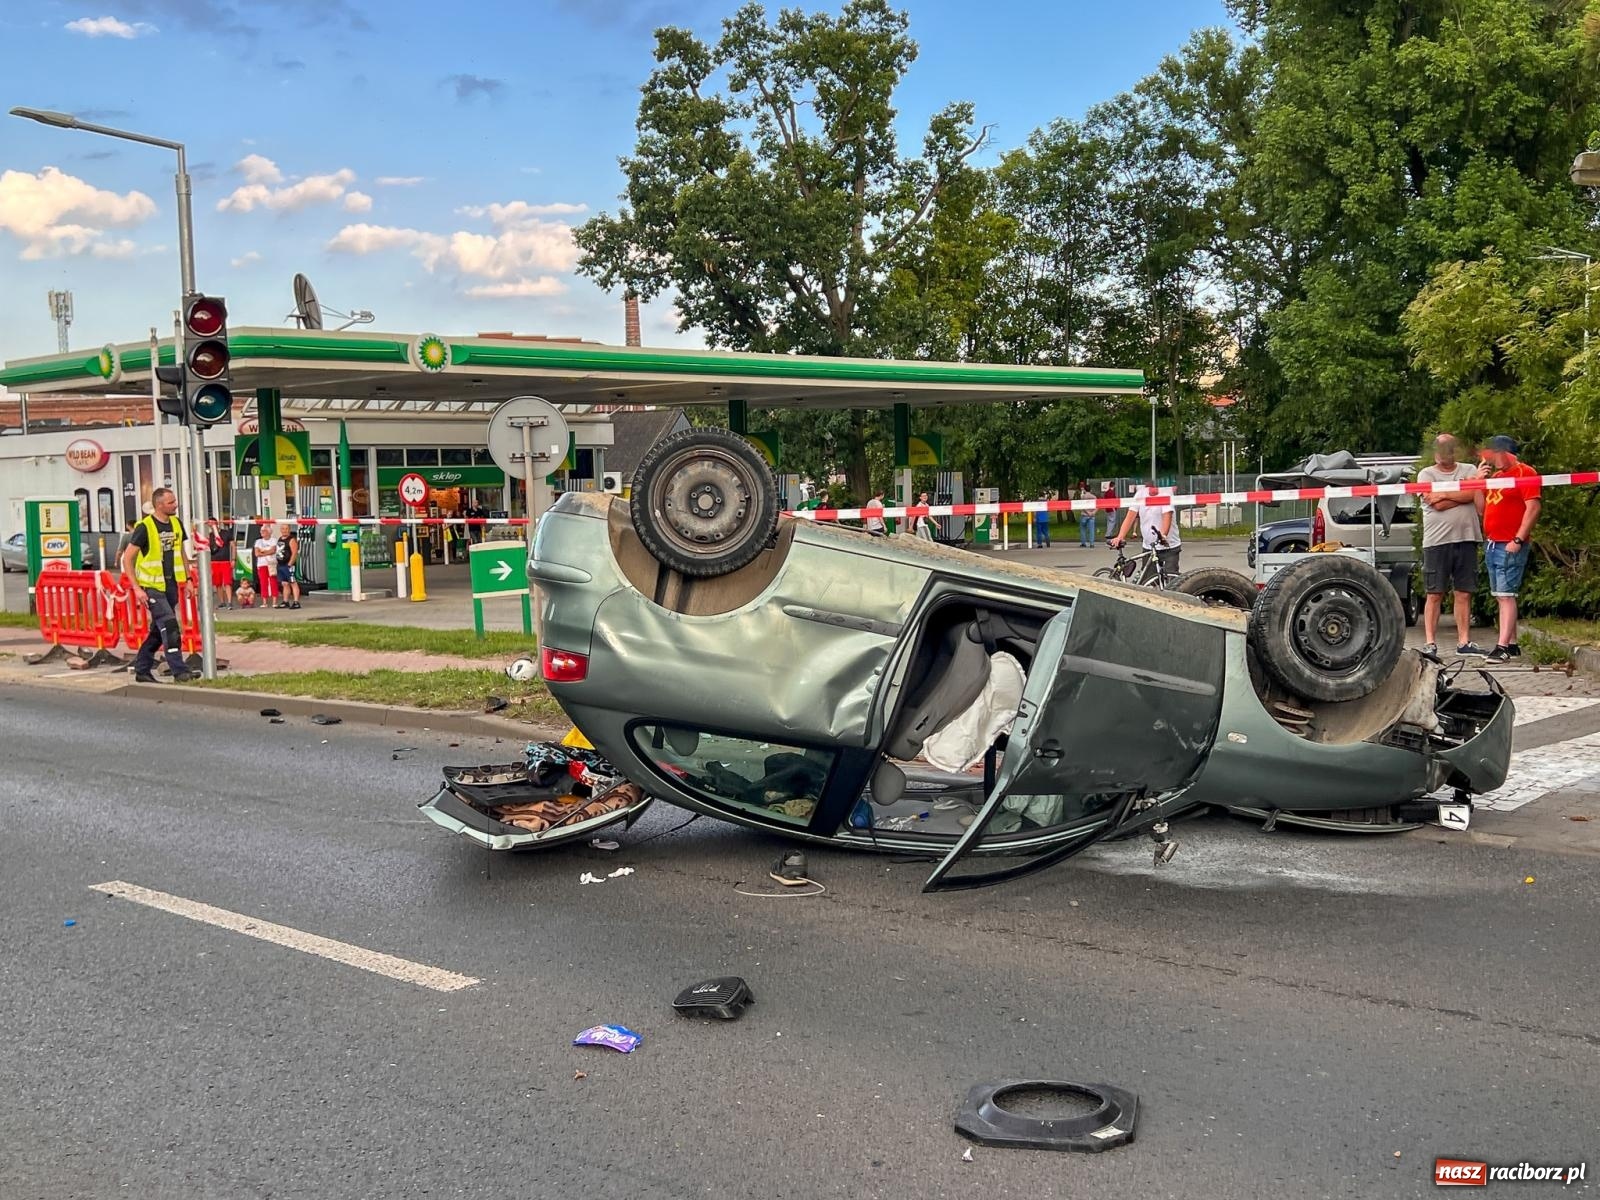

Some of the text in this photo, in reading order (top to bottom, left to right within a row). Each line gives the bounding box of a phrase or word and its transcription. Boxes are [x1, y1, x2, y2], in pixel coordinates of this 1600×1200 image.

[80, 449, 97, 459] BEAN
[431, 471, 462, 483] sklep
[46, 541, 66, 549] DKV
